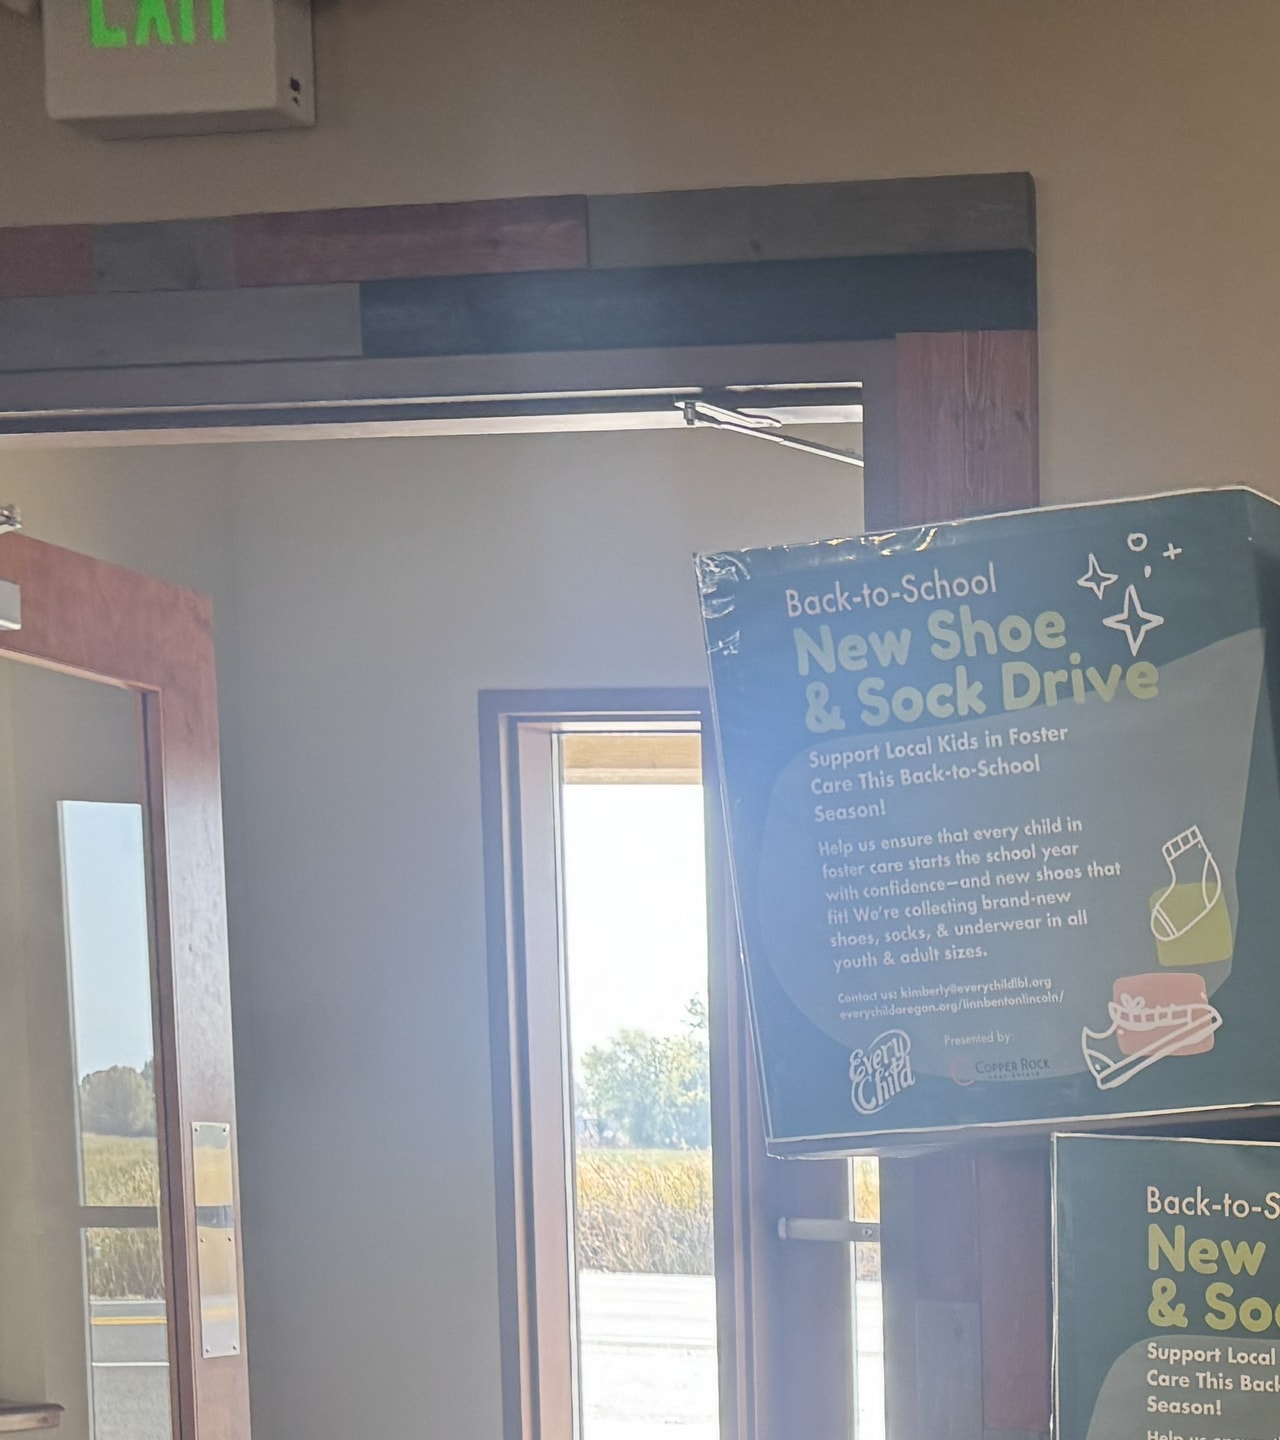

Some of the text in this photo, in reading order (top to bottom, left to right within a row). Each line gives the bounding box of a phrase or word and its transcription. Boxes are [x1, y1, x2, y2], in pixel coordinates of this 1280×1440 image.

[786, 562, 997, 618] Back-to-School
[792, 604, 1065, 677] New Shoe
[803, 652, 1158, 734] & Sock Drive
[807, 726, 1068, 770] Support Local Kids in Foster
[832, 943, 988, 974] youth & adult sizes.
[1146, 1223, 1267, 1276] New
[1147, 1277, 1188, 1328] &
[1146, 1369, 1190, 1387] Care
[1195, 1370, 1233, 1390] This
